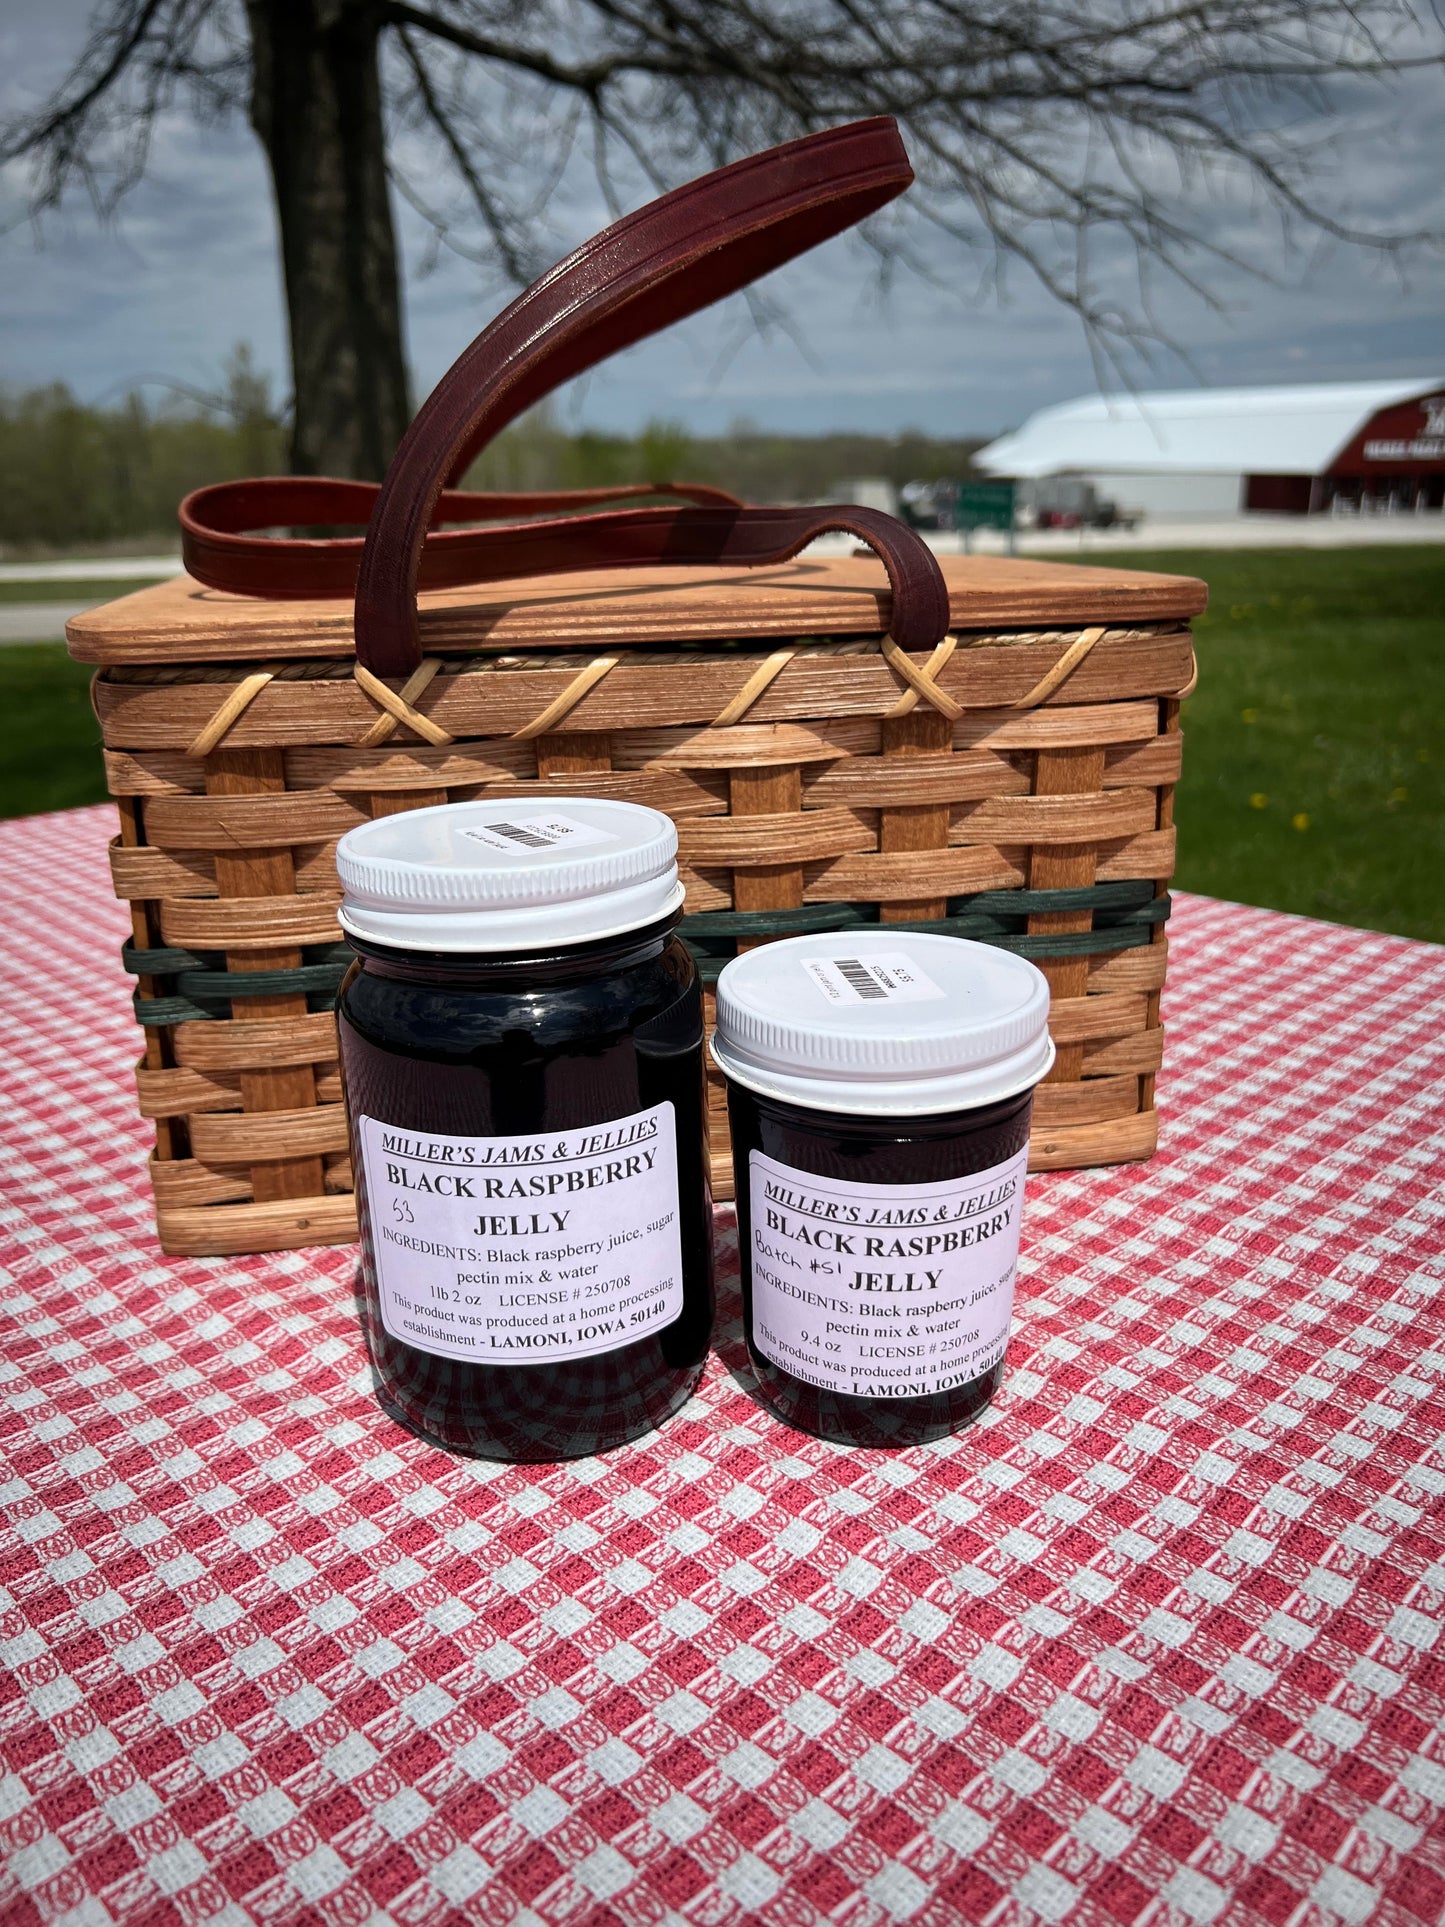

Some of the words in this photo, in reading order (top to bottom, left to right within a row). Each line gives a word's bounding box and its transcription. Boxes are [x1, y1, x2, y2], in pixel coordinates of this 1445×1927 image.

[481, 1144, 545, 1163] JAMS
[552, 1142, 568, 1159] &
[576, 1116, 658, 1155] JELLIES
[385, 1162, 477, 1199] BLACK
[484, 1147, 658, 1198] RASPBERRY
[473, 1210, 571, 1236] JELLY
[865, 1207, 928, 1224] JAMS
[933, 1205, 948, 1220] &
[954, 1176, 1018, 1218] JELLIES
[382, 1226, 482, 1262] INGREDIENTS:
[487, 1249, 530, 1263] Black
[535, 1238, 605, 1265] raspberry
[606, 1227, 643, 1250] juice,
[646, 1211, 674, 1234] sugar
[766, 1208, 856, 1255] BLACK
[864, 1204, 1014, 1256] RASPBERRY
[452, 1290, 461, 1302] 2
[465, 1294, 482, 1306] oz
[457, 1271, 499, 1285] pectin
[505, 1272, 533, 1284] mix
[539, 1270, 551, 1282] &
[558, 1264, 599, 1280] water
[499, 1290, 568, 1307] LICENSE
[573, 1288, 582, 1299] #
[585, 1274, 631, 1298] 250708
[755, 1264, 854, 1314] INGREDIENTS:
[859, 1304, 901, 1316] Black
[906, 1294, 968, 1318] raspberry
[969, 1282, 997, 1306] juice,
[849, 1269, 944, 1292] JELLY
[393, 1291, 412, 1309] This
[414, 1301, 455, 1322] product
[458, 1313, 482, 1326] was
[486, 1314, 548, 1329] produced
[553, 1313, 564, 1324] at
[569, 1313, 576, 1321] a
[580, 1303, 616, 1319] home
[618, 1276, 674, 1309] processing
[403, 1319, 476, 1346] establishment
[490, 1332, 572, 1348] LAMONI,
[577, 1318, 626, 1341] IOWA
[630, 1300, 665, 1326] 50140
[759, 1322, 777, 1344] This
[779, 1341, 820, 1367] product
[822, 1360, 847, 1373] was
[851, 1364, 911, 1378] produced
[915, 1365, 926, 1375] at
[930, 1363, 937, 1372] a
[940, 1351, 970, 1372] home
[801, 1331, 821, 1347] 9.4
[825, 1341, 842, 1352] oz
[826, 1321, 869, 1336] pectin
[874, 1326, 902, 1337] mix
[906, 1324, 919, 1336] &
[925, 1318, 961, 1334] water
[859, 1344, 925, 1358] LICENSE
[929, 1344, 937, 1354] #
[940, 1329, 980, 1353] 250708
[767, 1350, 838, 1390] establishment
[853, 1382, 931, 1397] LAMONI,
[936, 1368, 976, 1390] IOWA
